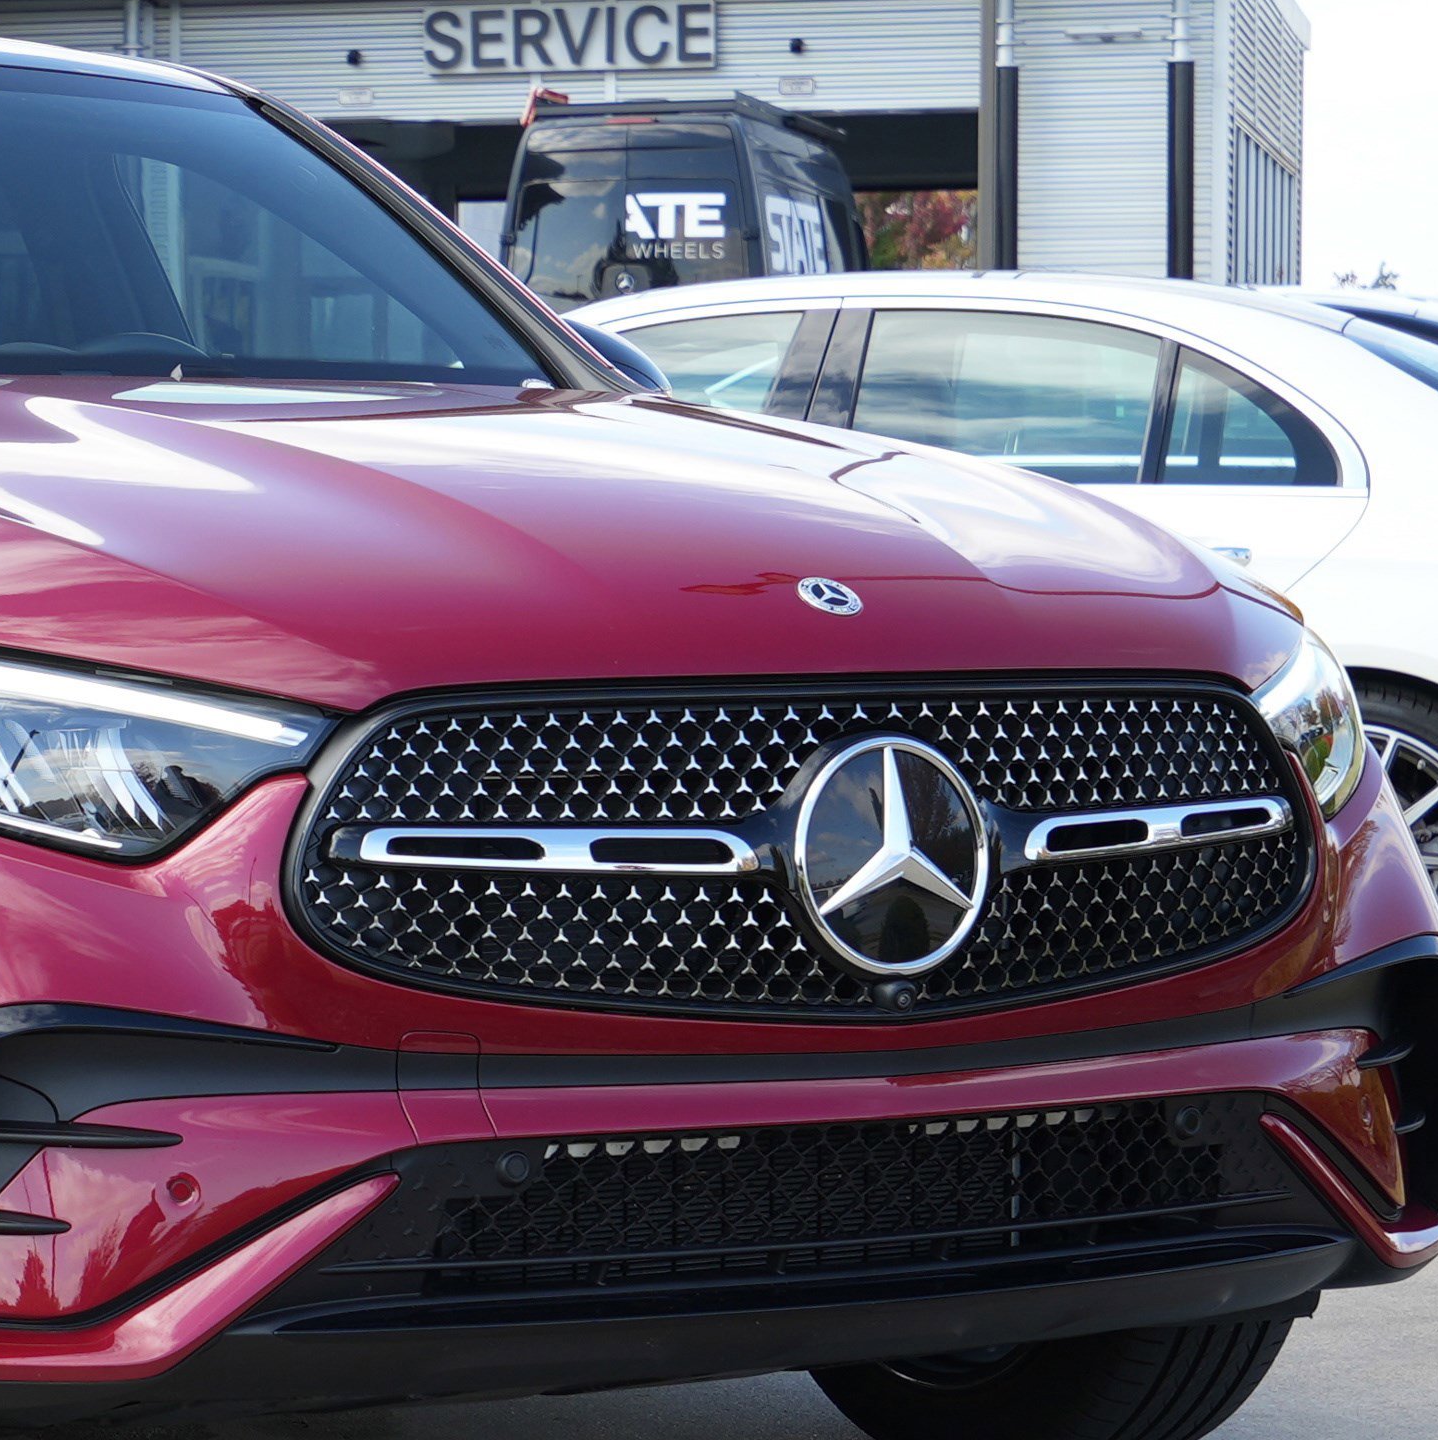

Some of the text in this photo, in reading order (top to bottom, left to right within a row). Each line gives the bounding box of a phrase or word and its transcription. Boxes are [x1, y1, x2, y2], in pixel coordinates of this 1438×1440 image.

[424, 4, 712, 70] SERVICE
[633, 241, 726, 260] WHEELS
[765, 194, 828, 276] STATE
